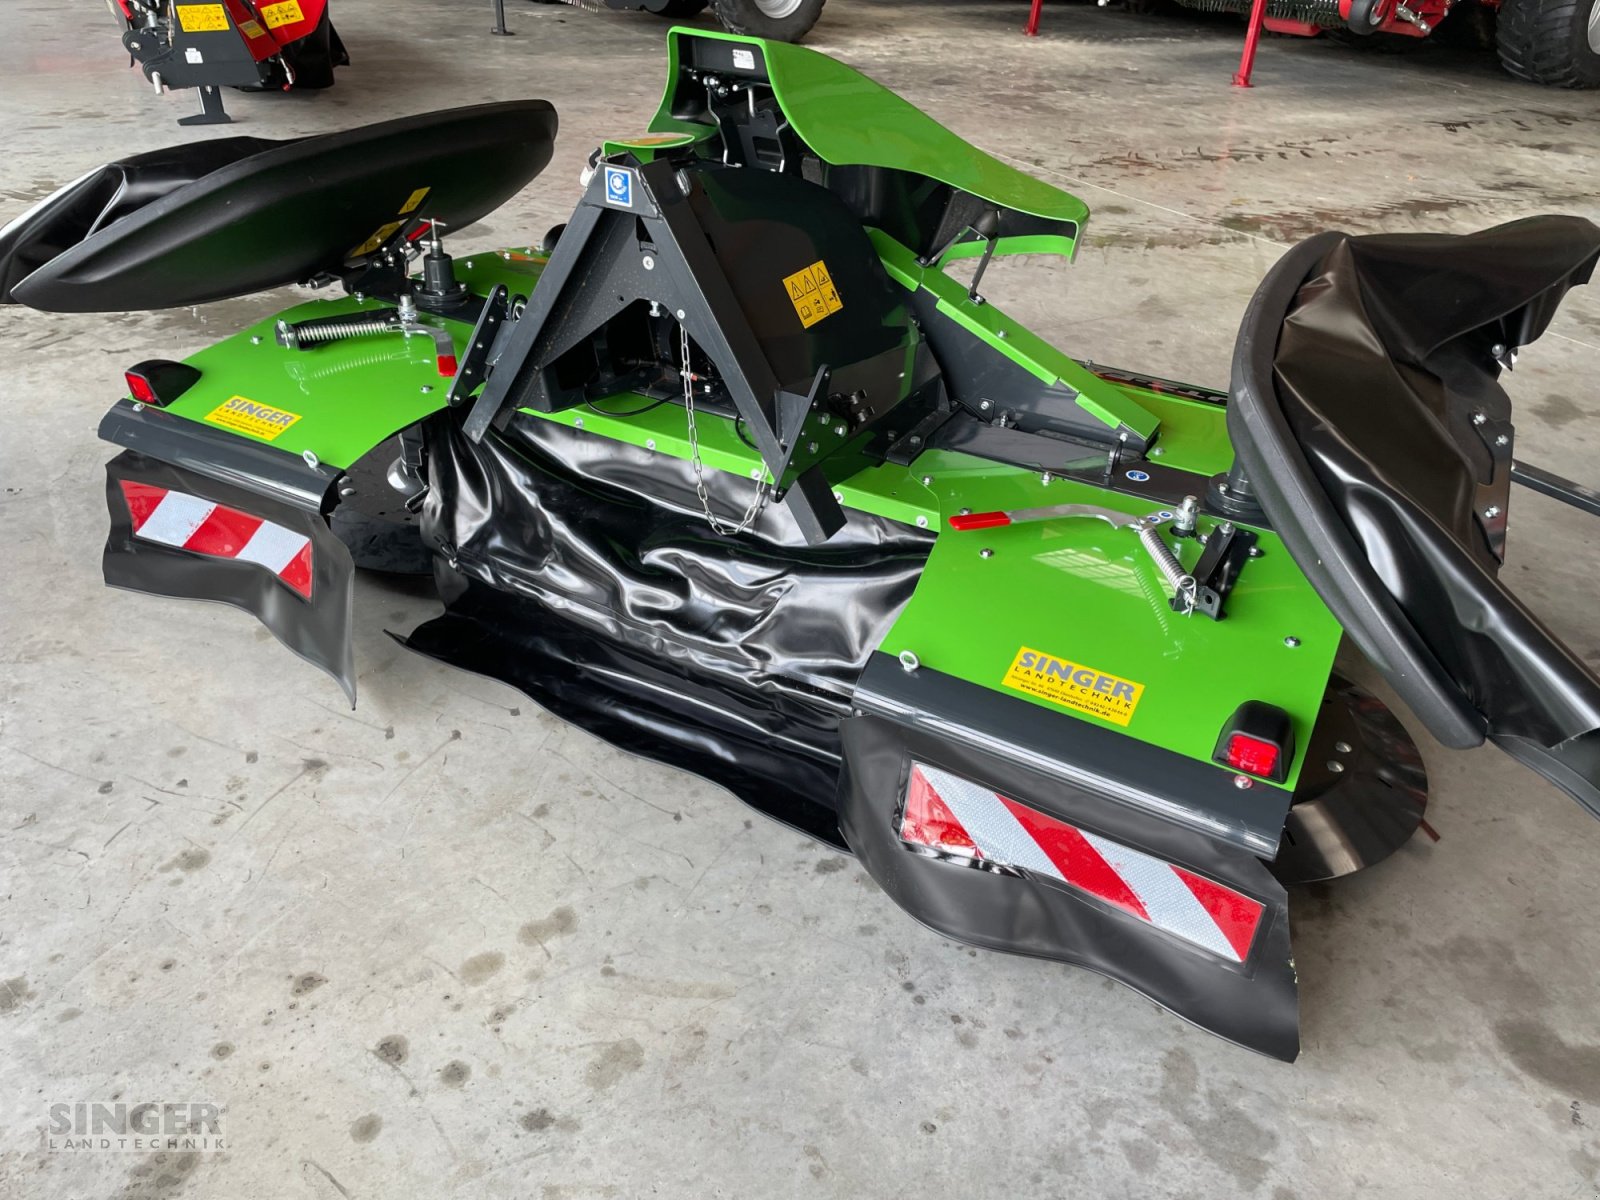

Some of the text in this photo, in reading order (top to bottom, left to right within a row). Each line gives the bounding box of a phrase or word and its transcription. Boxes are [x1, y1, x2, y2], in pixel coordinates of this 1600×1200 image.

[225, 398, 294, 427] SINGER
[1014, 666, 1132, 709] LANDTECHNIK
[1018, 651, 1135, 702] SINGER
[1020, 683, 1111, 717] www.singer-landtechnik.de
